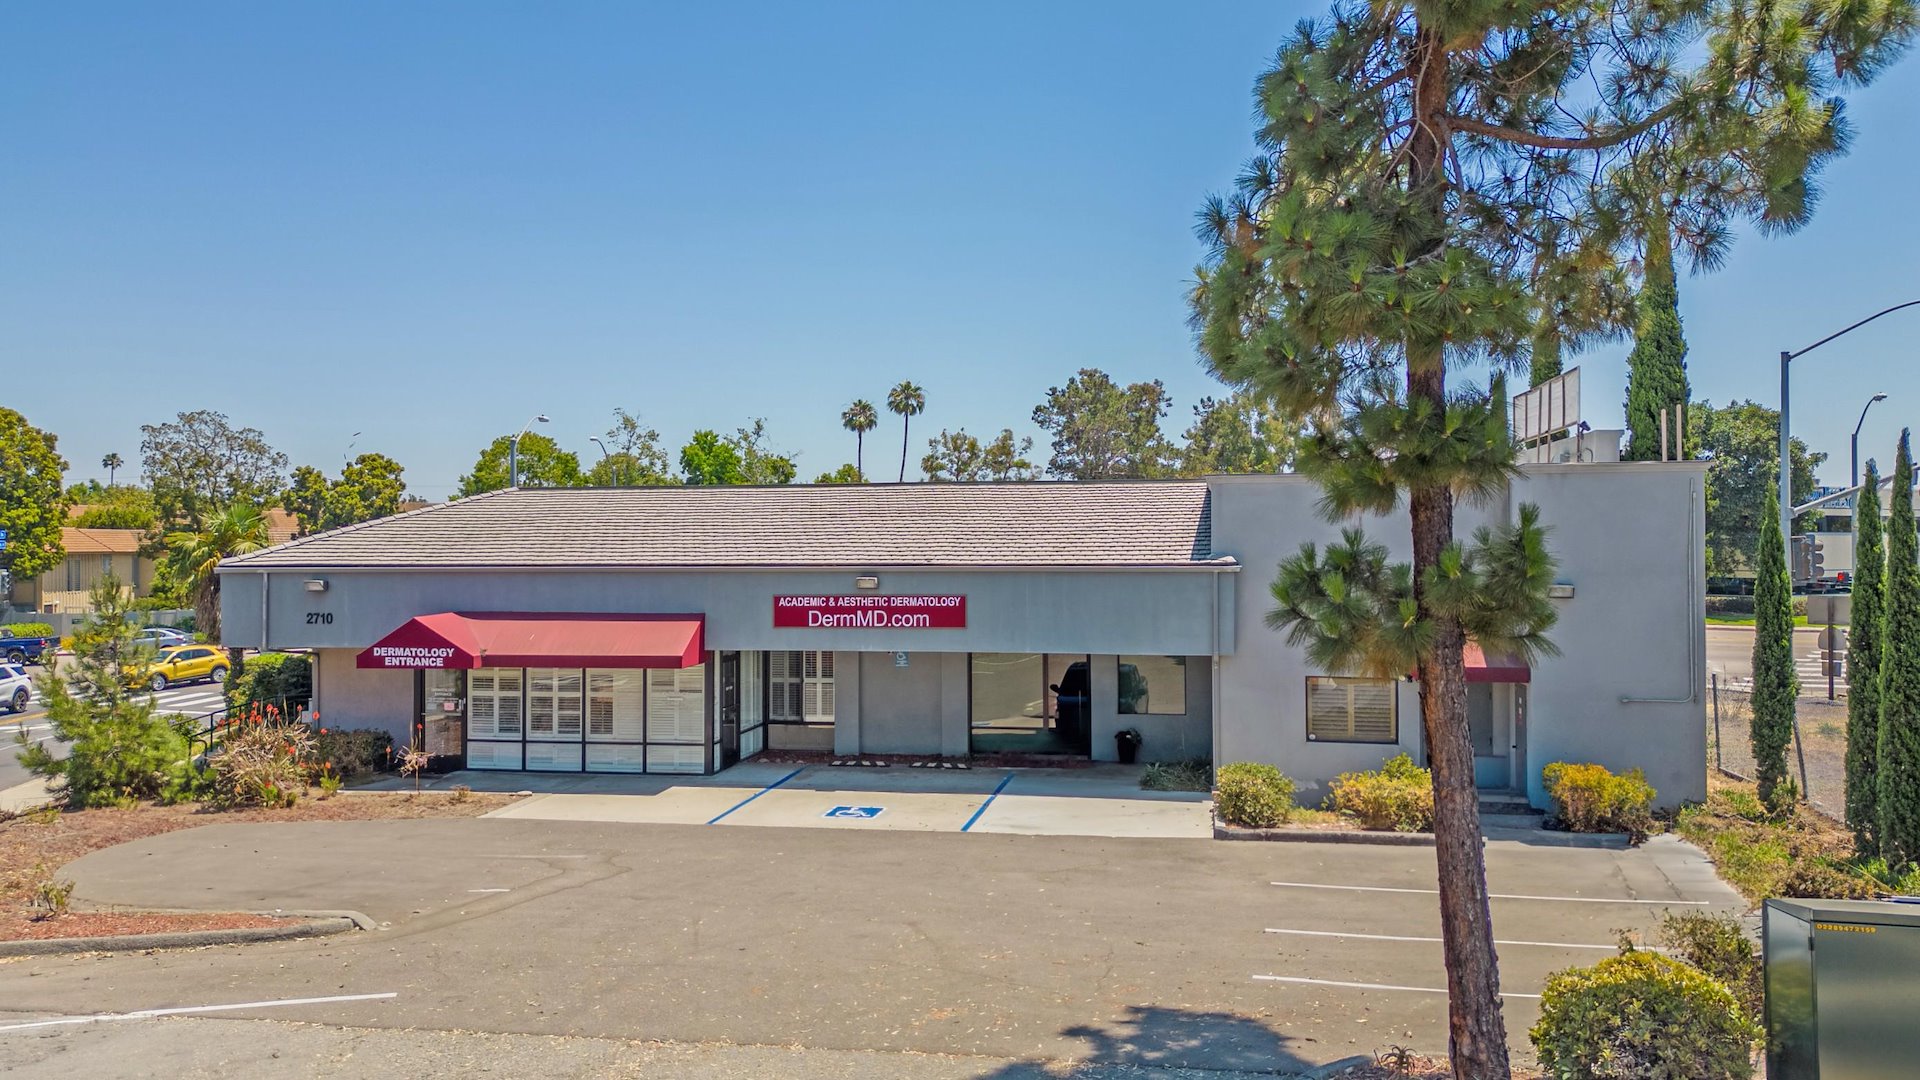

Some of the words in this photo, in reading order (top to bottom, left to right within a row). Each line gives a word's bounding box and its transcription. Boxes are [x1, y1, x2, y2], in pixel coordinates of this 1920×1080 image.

[779, 597, 826, 607] ACADEMIC
[828, 597, 834, 607] &
[837, 597, 888, 607] AESTHETIC
[890, 597, 961, 607] DERMATOLOGY
[306, 612, 333, 624] 2710
[808, 610, 930, 627] DermMD.com
[373, 647, 455, 657] DERMATOLOGY
[384, 657, 444, 667] ENTRANCE
